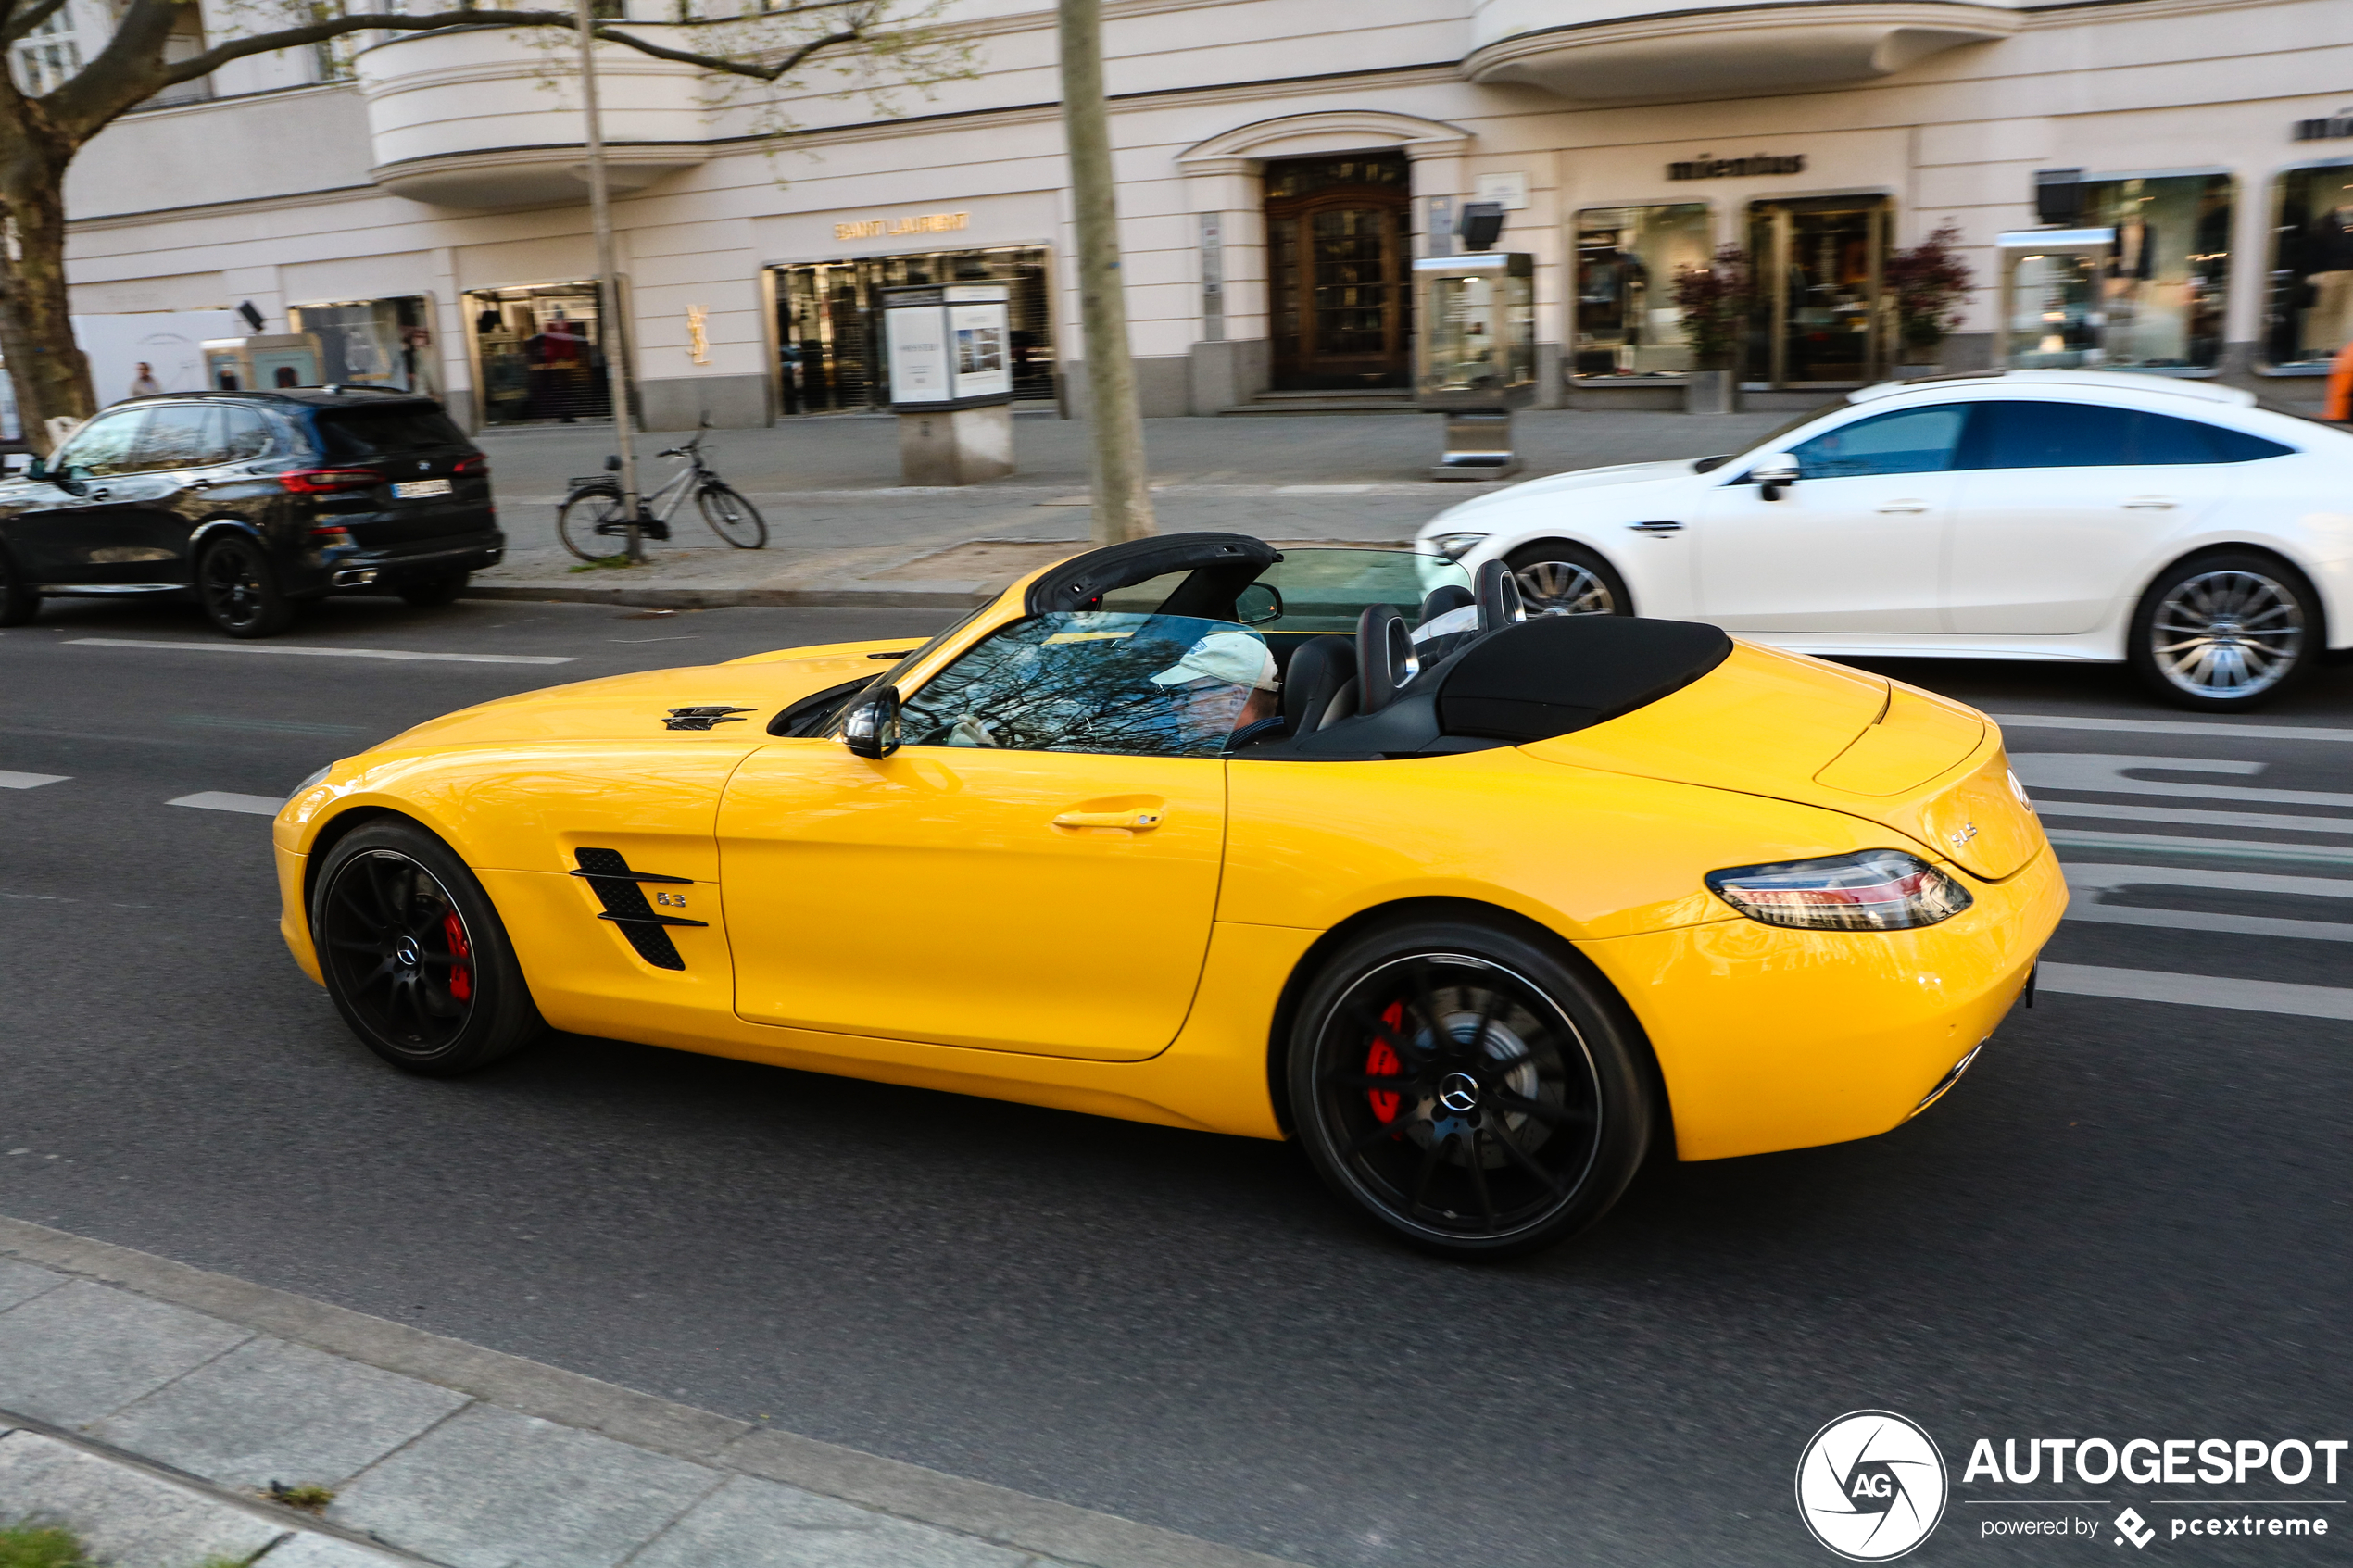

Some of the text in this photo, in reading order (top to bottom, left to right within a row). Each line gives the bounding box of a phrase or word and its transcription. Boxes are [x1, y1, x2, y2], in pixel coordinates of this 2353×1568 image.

[835, 211, 970, 240] SAINT LAURENT
[1951, 822, 1978, 848] SLS
[657, 892, 686, 908] 6.3
